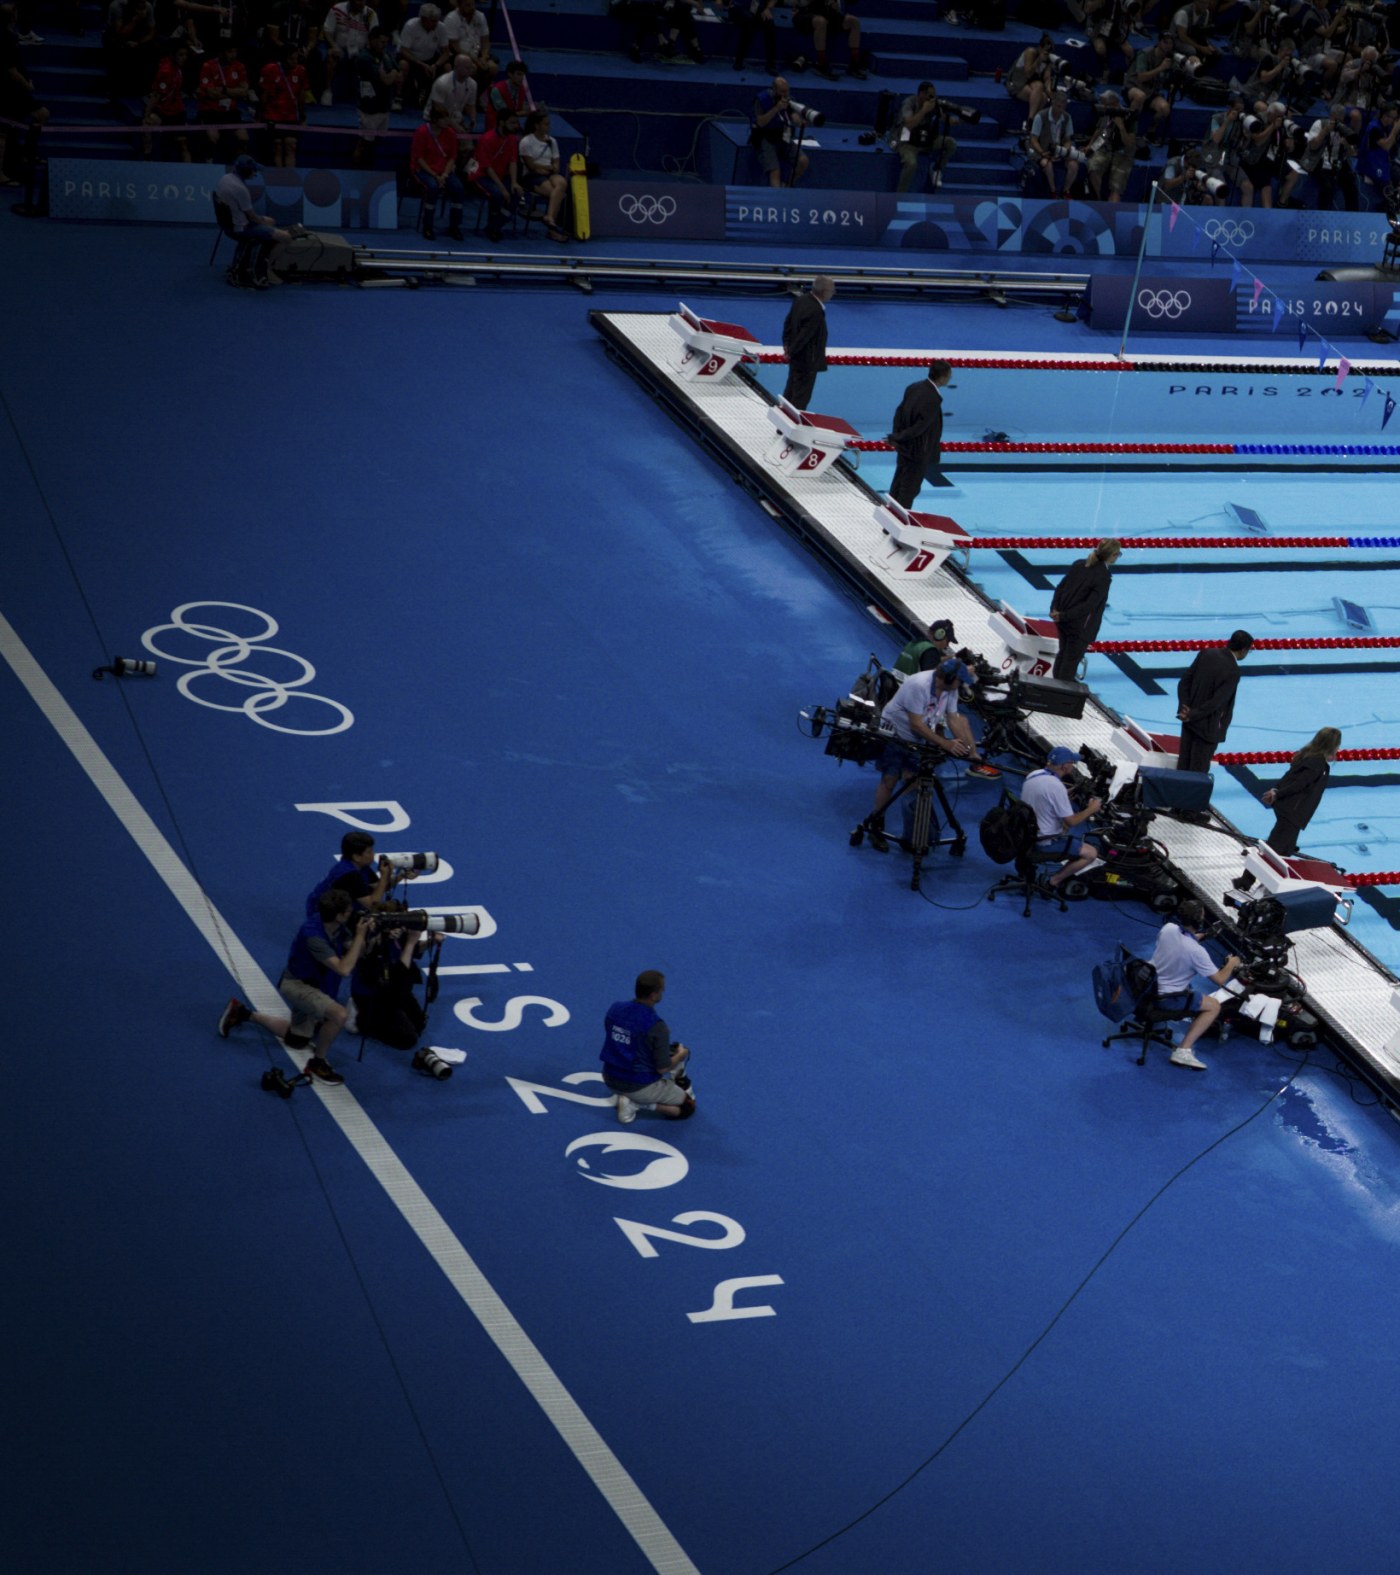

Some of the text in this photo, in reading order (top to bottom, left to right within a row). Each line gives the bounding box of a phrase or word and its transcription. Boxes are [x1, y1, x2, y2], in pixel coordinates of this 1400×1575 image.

[148, 184, 212, 201] 2024
[739, 206, 864, 226] PARIS 2024
[1308, 229, 1361, 245] PARIS
[1249, 299, 1363, 316] PAIS 2024
[708, 359, 719, 373] 9
[1169, 385, 1391, 397] PARIS 2024
[780, 443, 794, 460] 8
[808, 453, 819, 467] 8
[918, 554, 928, 569] 7
[1001, 653, 1018, 670] 6
[1032, 663, 1044, 677] 6
[504, 1071, 785, 1324] 2024
